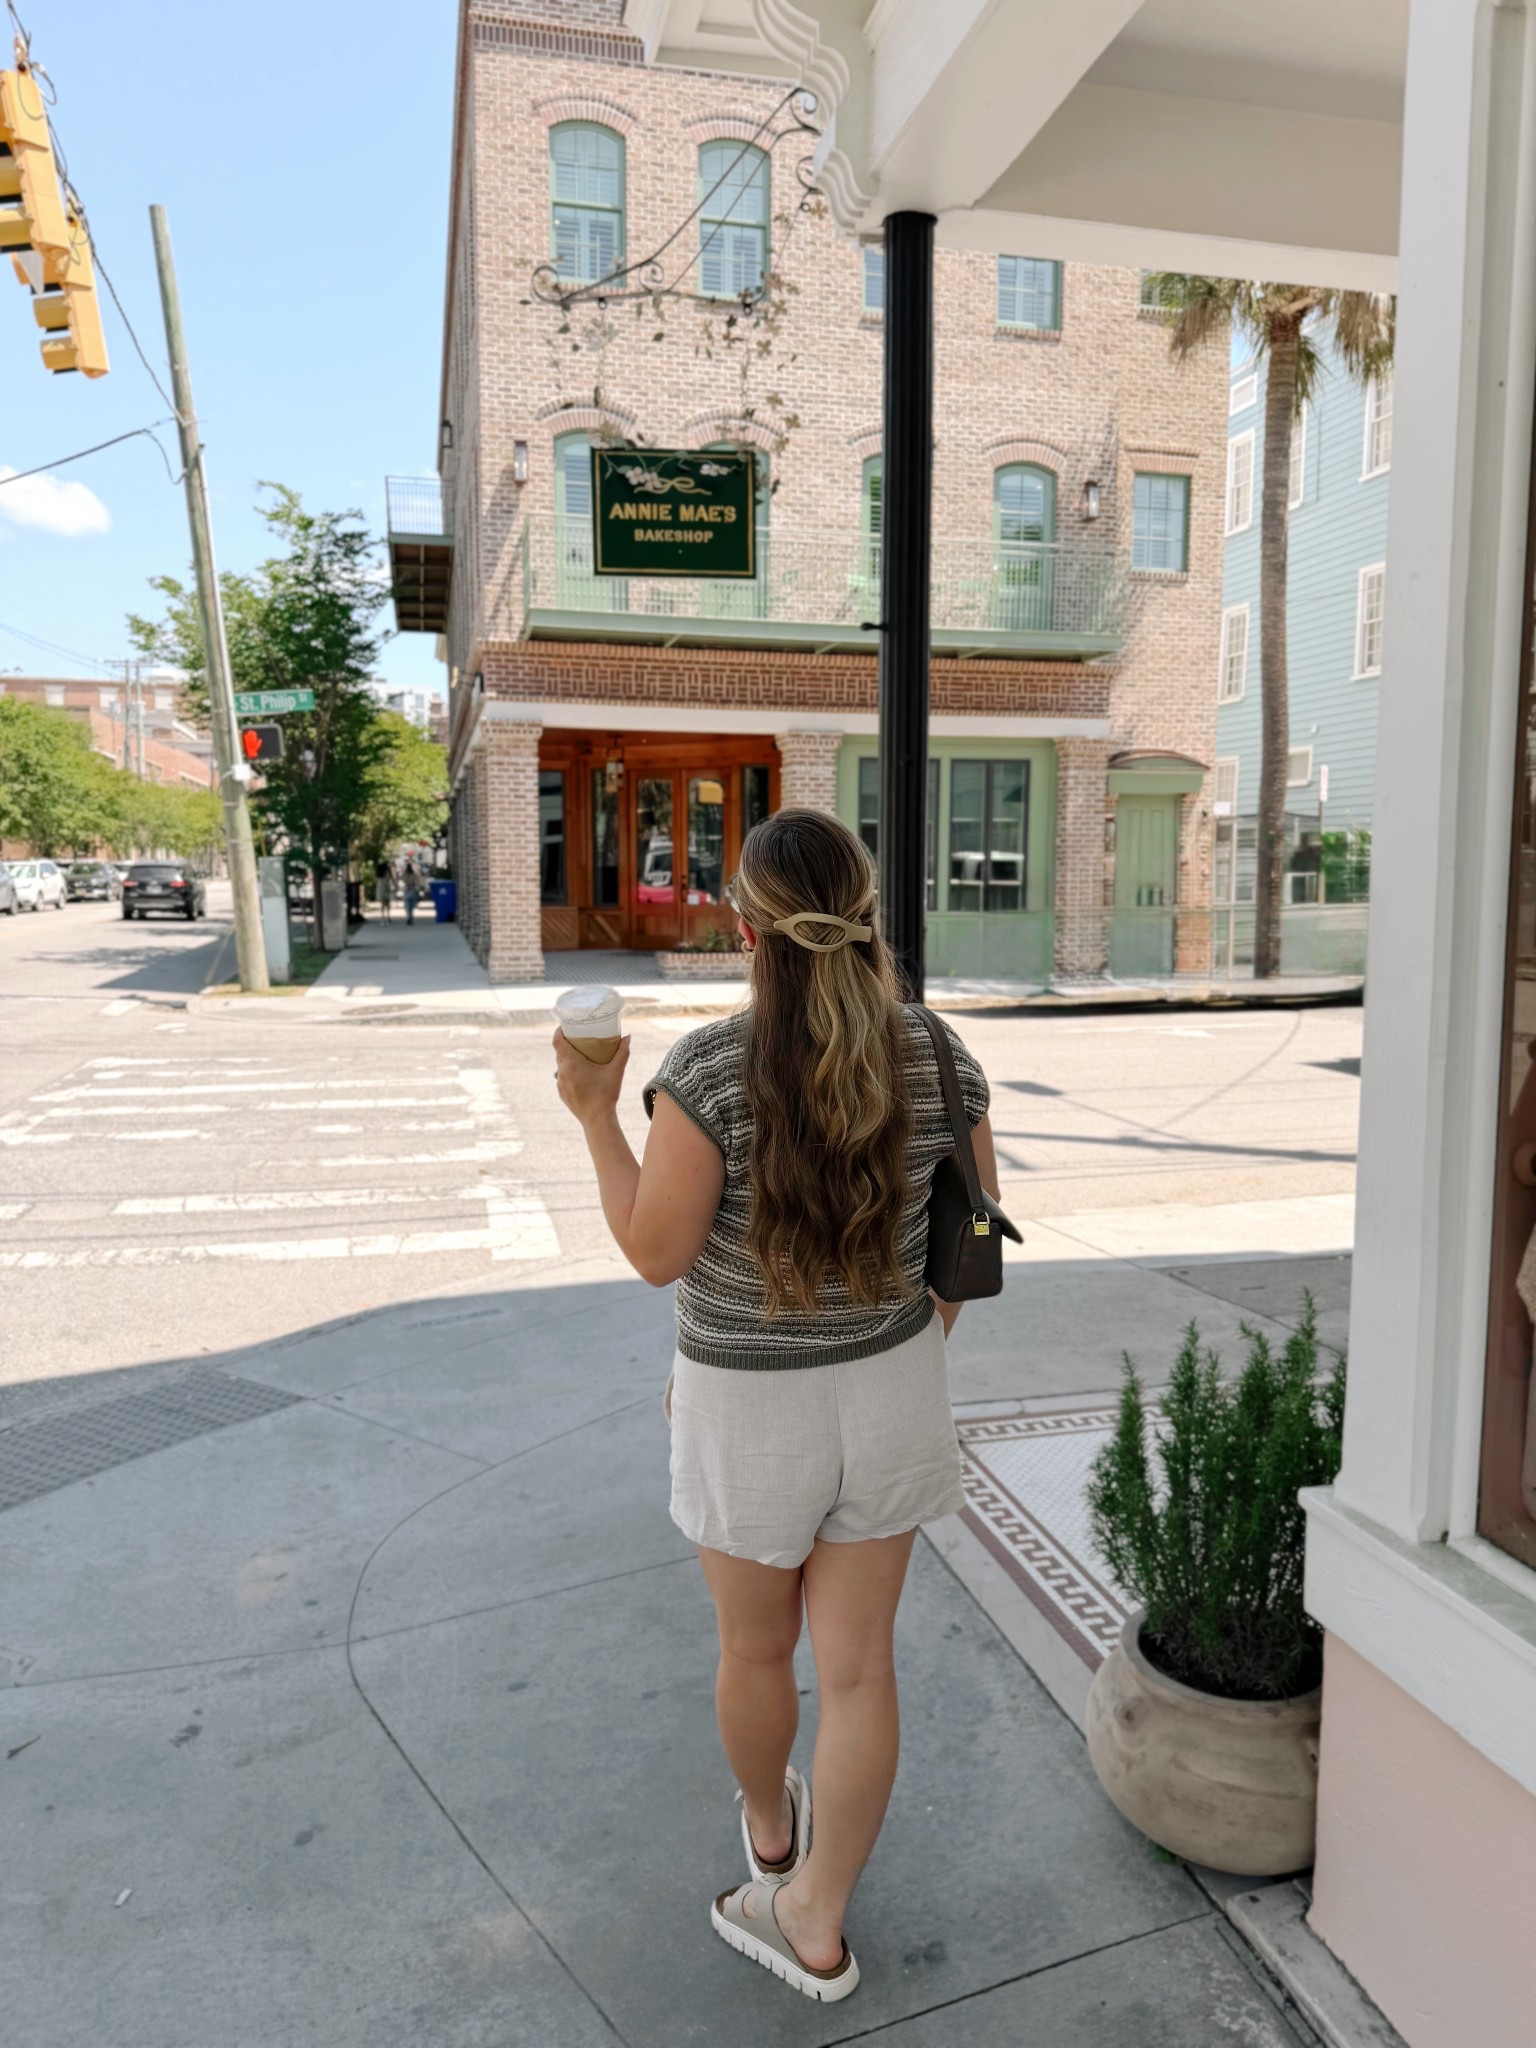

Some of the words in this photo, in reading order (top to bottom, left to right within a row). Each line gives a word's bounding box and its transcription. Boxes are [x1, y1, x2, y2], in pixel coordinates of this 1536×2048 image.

[609, 502, 672, 521] ANNIE
[679, 504, 737, 523] MAE'S
[634, 528, 714, 543] BAKESHOP
[239, 695, 259, 711] St.
[260, 693, 296, 711] Philip
